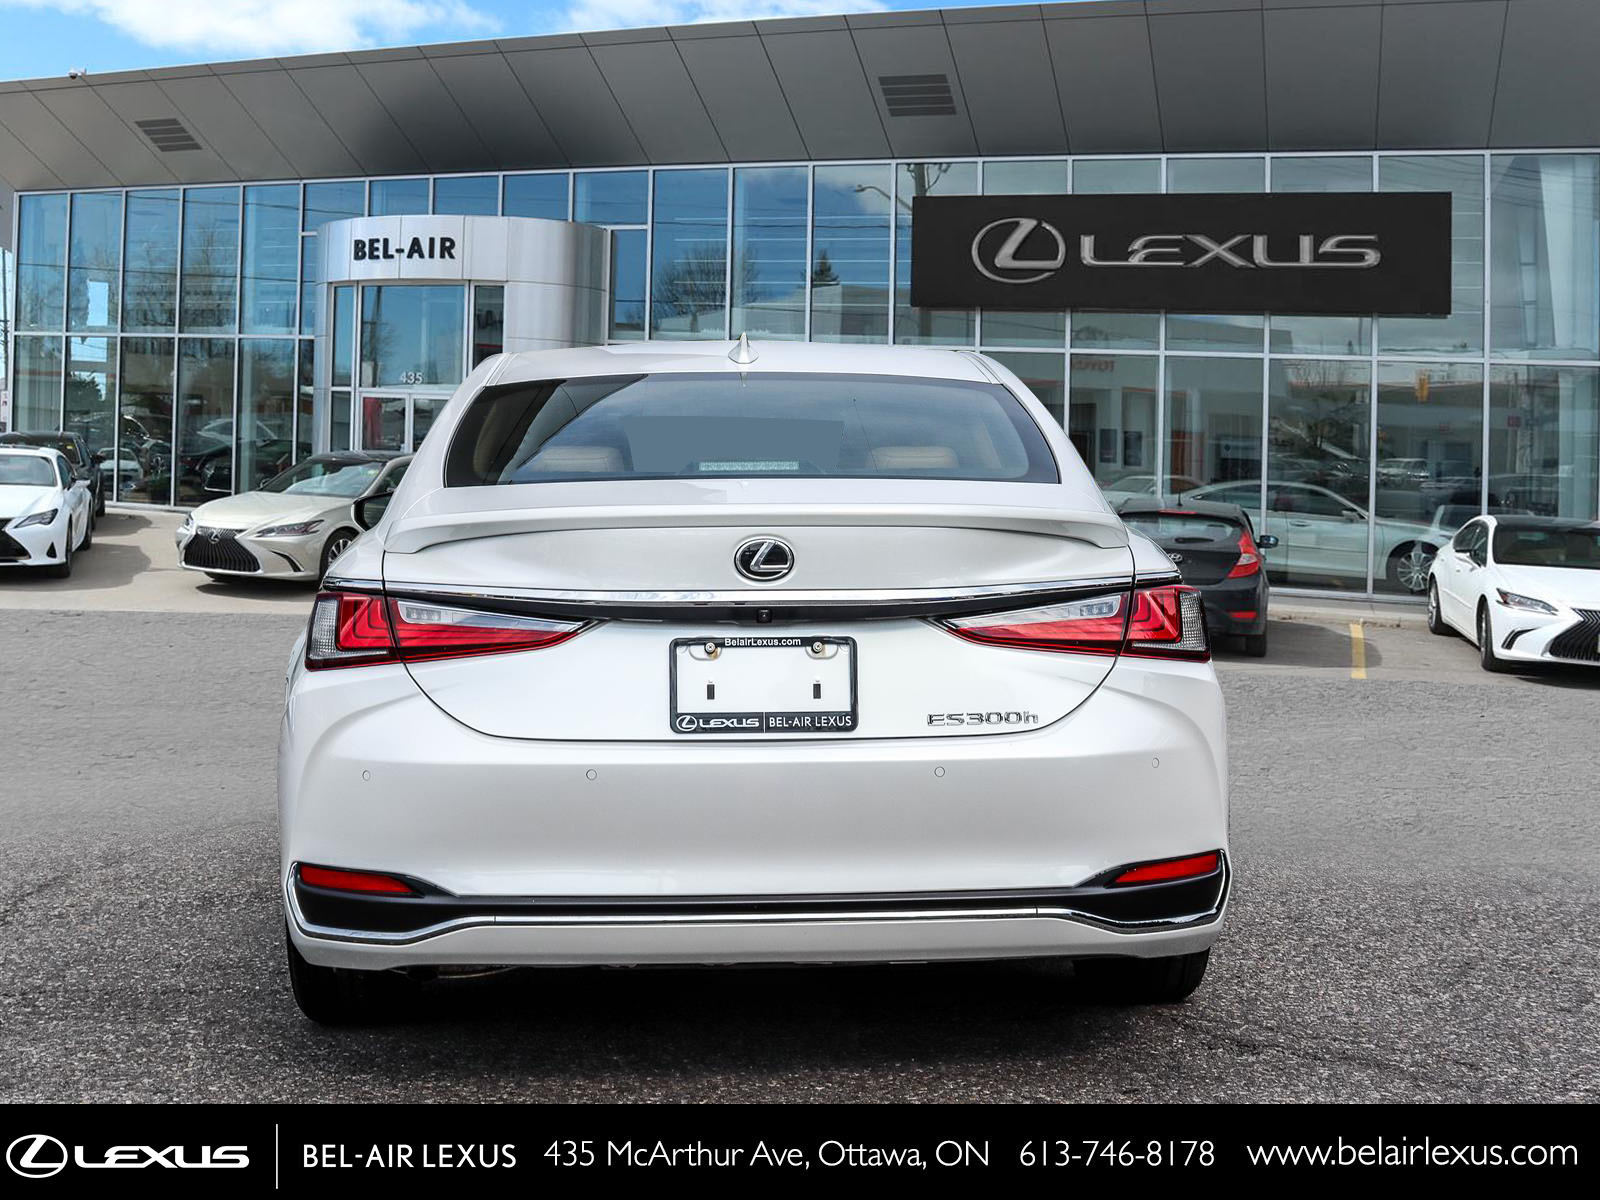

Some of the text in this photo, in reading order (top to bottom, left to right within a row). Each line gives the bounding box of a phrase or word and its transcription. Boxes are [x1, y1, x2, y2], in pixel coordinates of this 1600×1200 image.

[353, 237, 456, 261] BEL-AIR
[1080, 234, 1381, 268] LEXUS
[400, 371, 423, 385] 435
[724, 636, 802, 648] BelairLexus.com
[700, 718, 760, 728] LEXUS
[769, 715, 852, 728] BEL-AIR LEXUS
